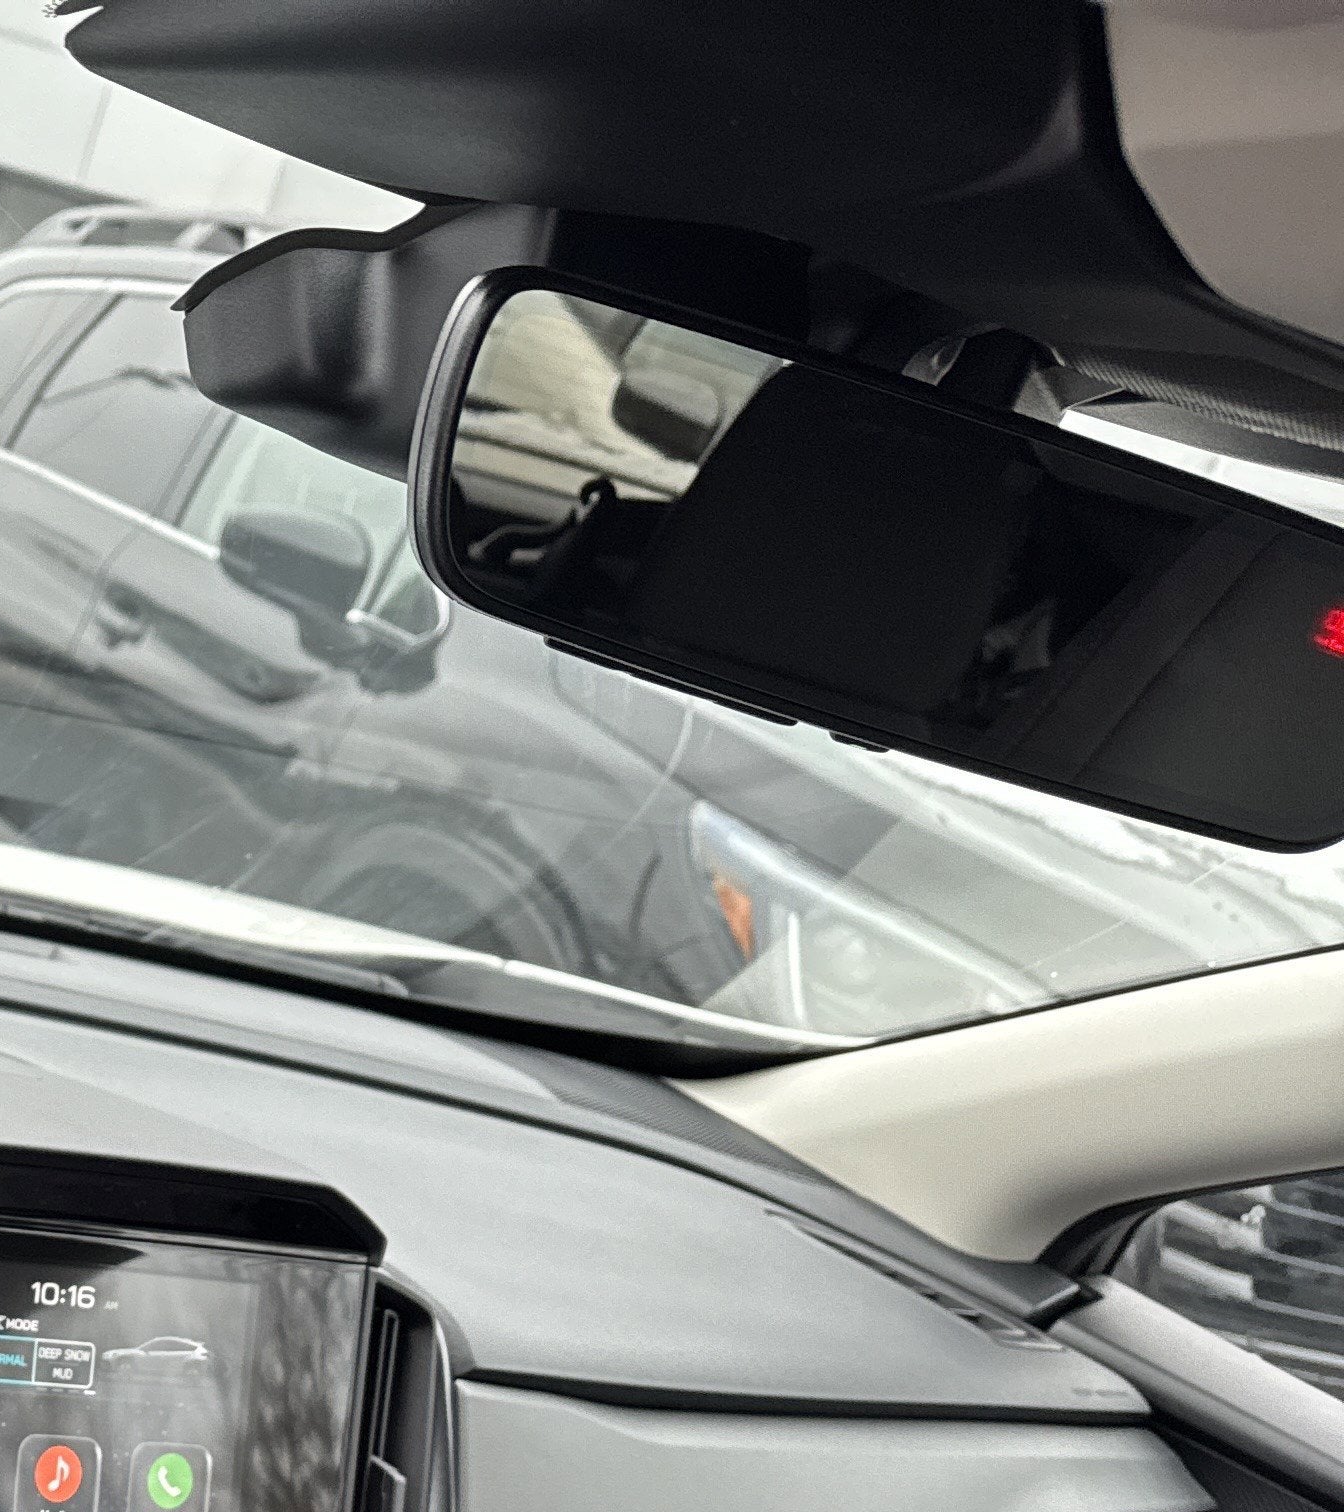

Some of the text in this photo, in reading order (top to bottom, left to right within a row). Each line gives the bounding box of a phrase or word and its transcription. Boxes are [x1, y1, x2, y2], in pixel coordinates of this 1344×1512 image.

[31, 1281, 96, 1309] 10:16
[38, 1347, 91, 1361] DEEP SNOW
[53, 1368, 73, 1380] MUD
